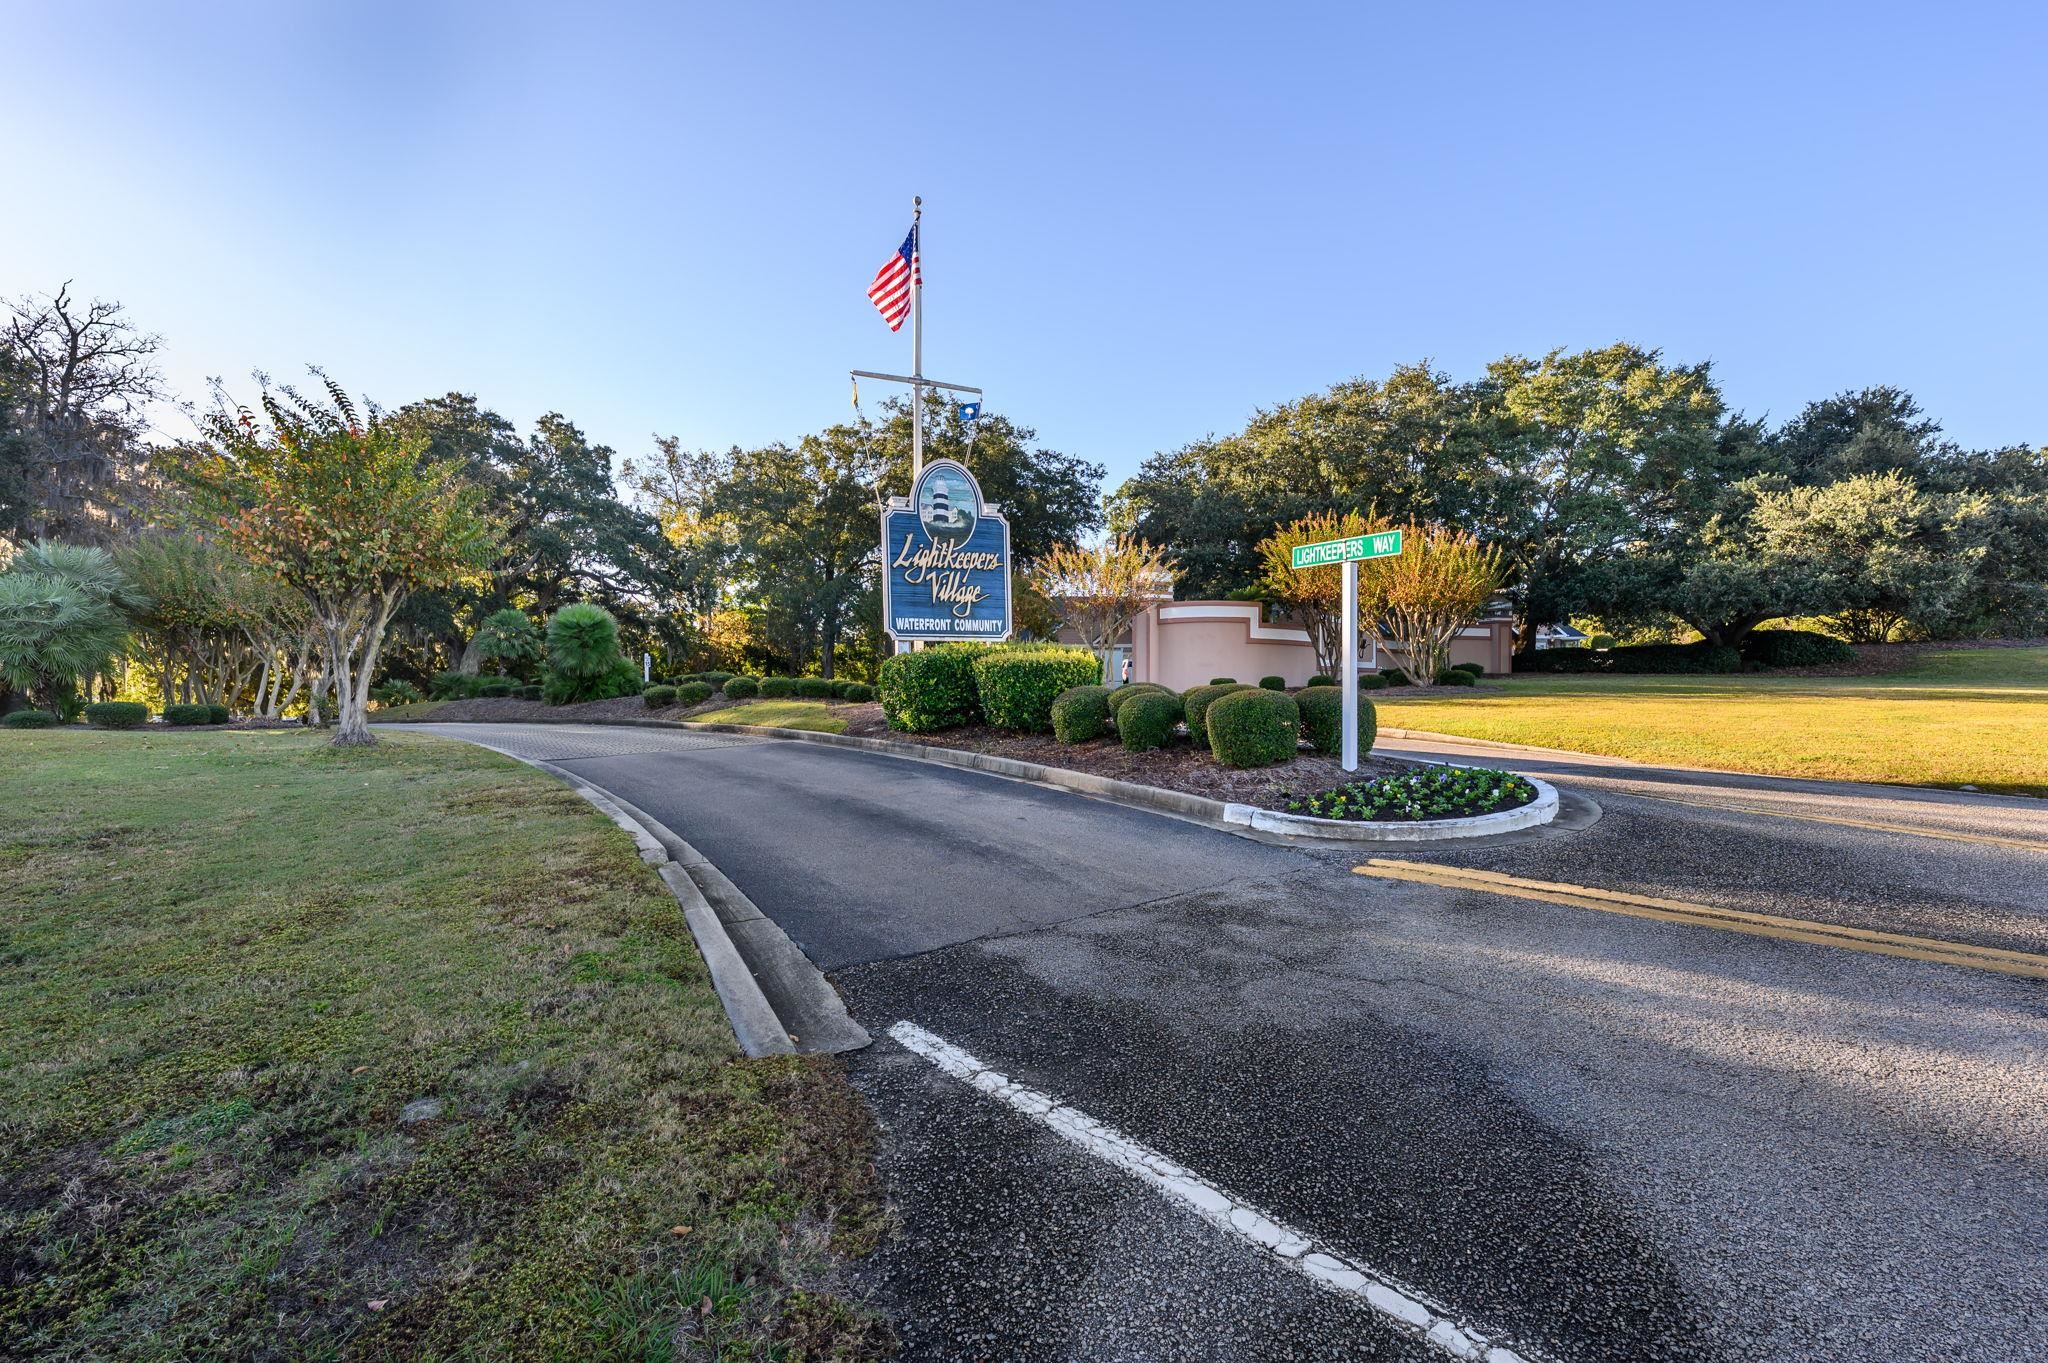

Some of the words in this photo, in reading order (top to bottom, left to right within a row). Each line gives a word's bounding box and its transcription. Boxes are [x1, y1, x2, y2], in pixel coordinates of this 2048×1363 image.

[892, 532, 1004, 584] Lightkeepers
[1296, 540, 1363, 564] LIGHTKEEPERS
[1373, 534, 1396, 554] WAY
[925, 571, 990, 618] Village
[895, 617, 951, 631] WATERFRONT
[954, 618, 1003, 632] COMMUNITY
